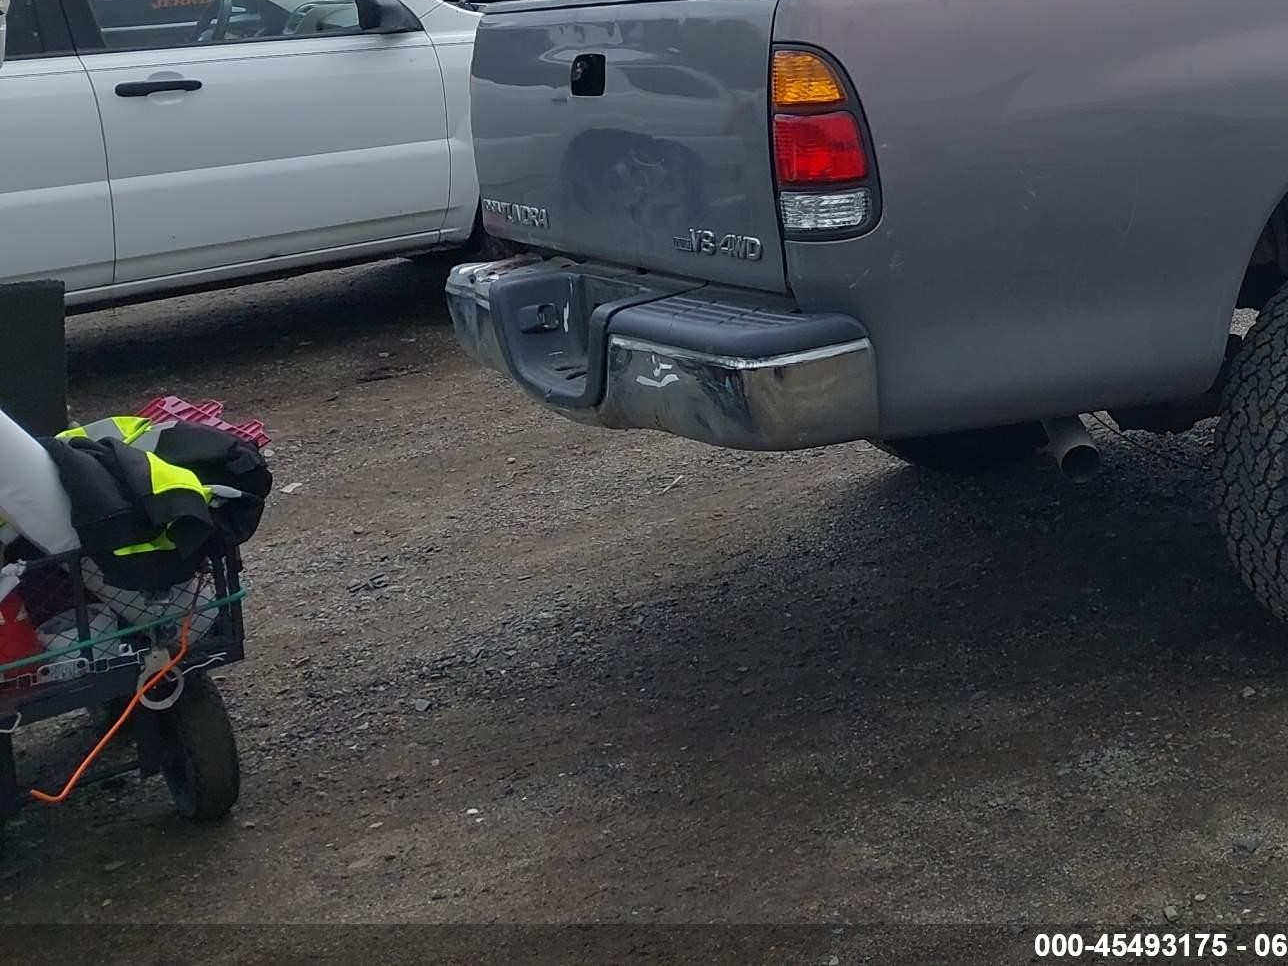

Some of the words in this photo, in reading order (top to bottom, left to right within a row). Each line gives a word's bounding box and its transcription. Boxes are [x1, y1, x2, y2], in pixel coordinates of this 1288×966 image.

[501, 202, 550, 229] TUNDRA
[689, 228, 716, 254] V8
[720, 234, 763, 260] 4WD
